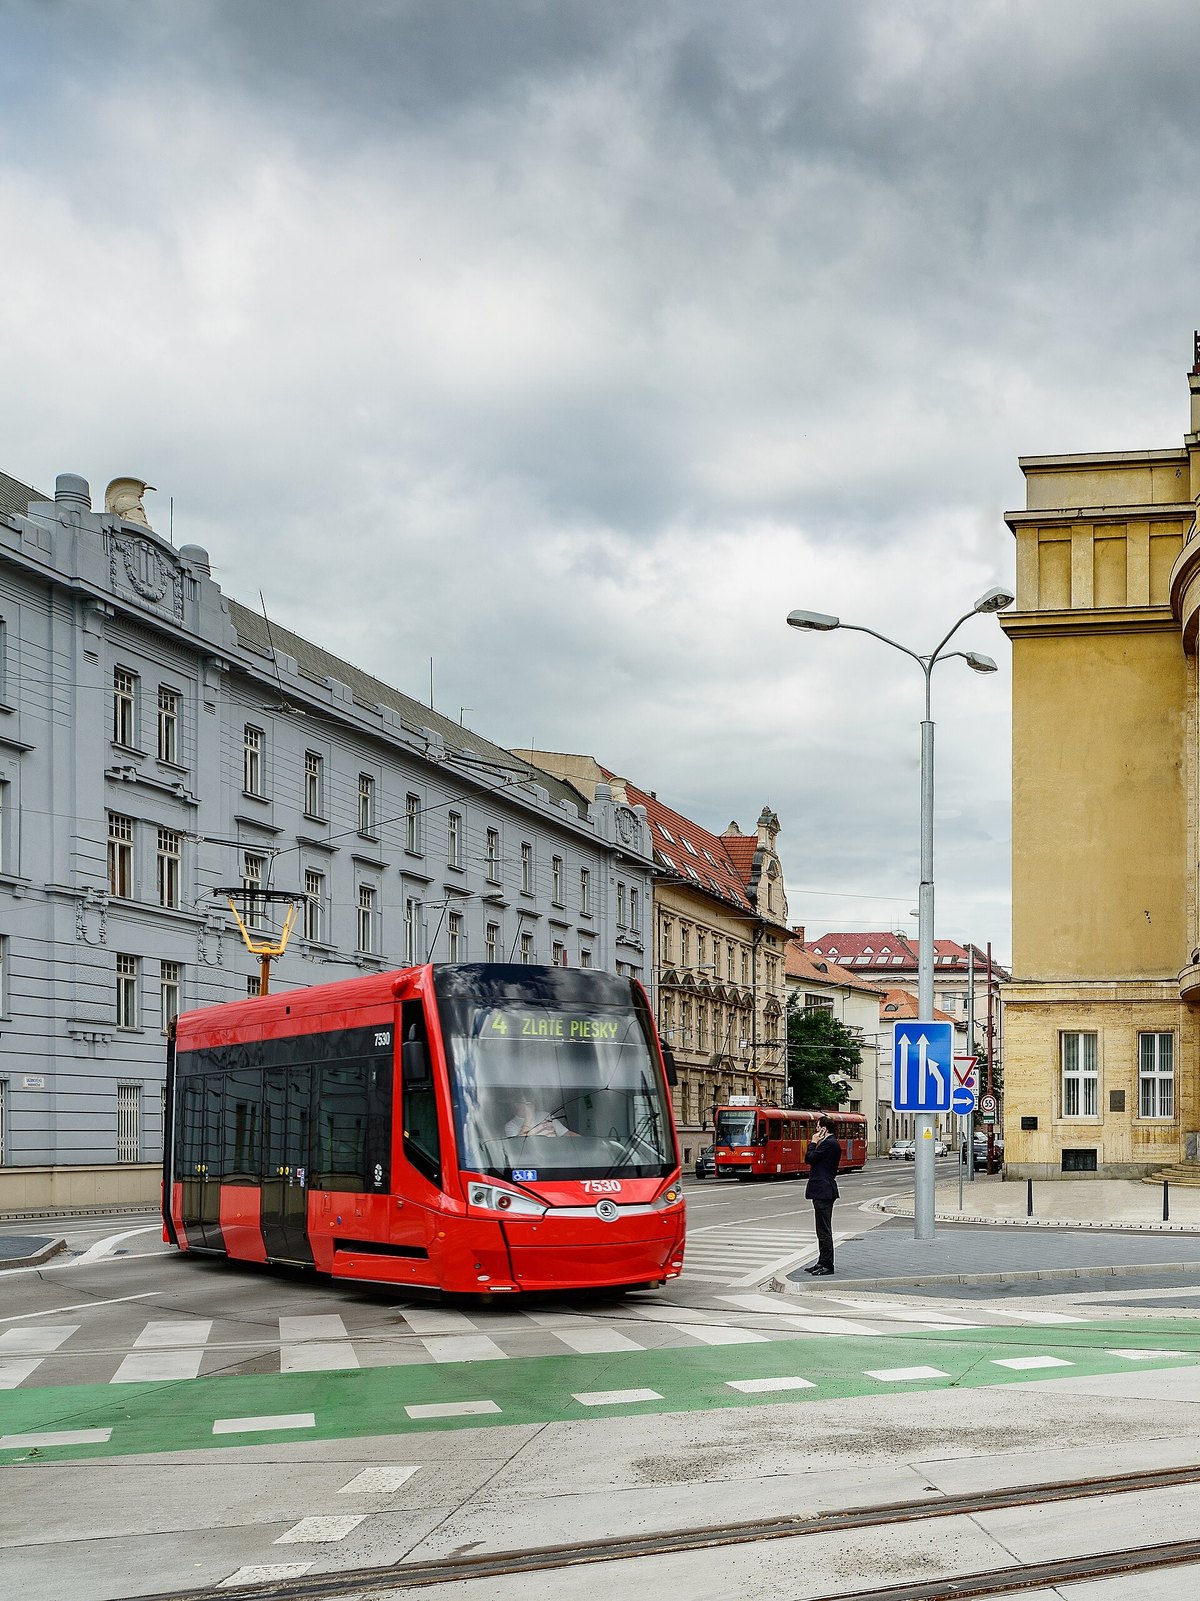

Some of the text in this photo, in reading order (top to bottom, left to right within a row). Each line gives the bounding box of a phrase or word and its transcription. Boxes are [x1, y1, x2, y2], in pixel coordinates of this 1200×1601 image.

[491, 1013, 618, 1039] 4 ZLATÉ PIESKY
[374, 1031, 391, 1046] 7530
[984, 1099, 993, 1108] 55
[580, 1179, 622, 1193] 7530
